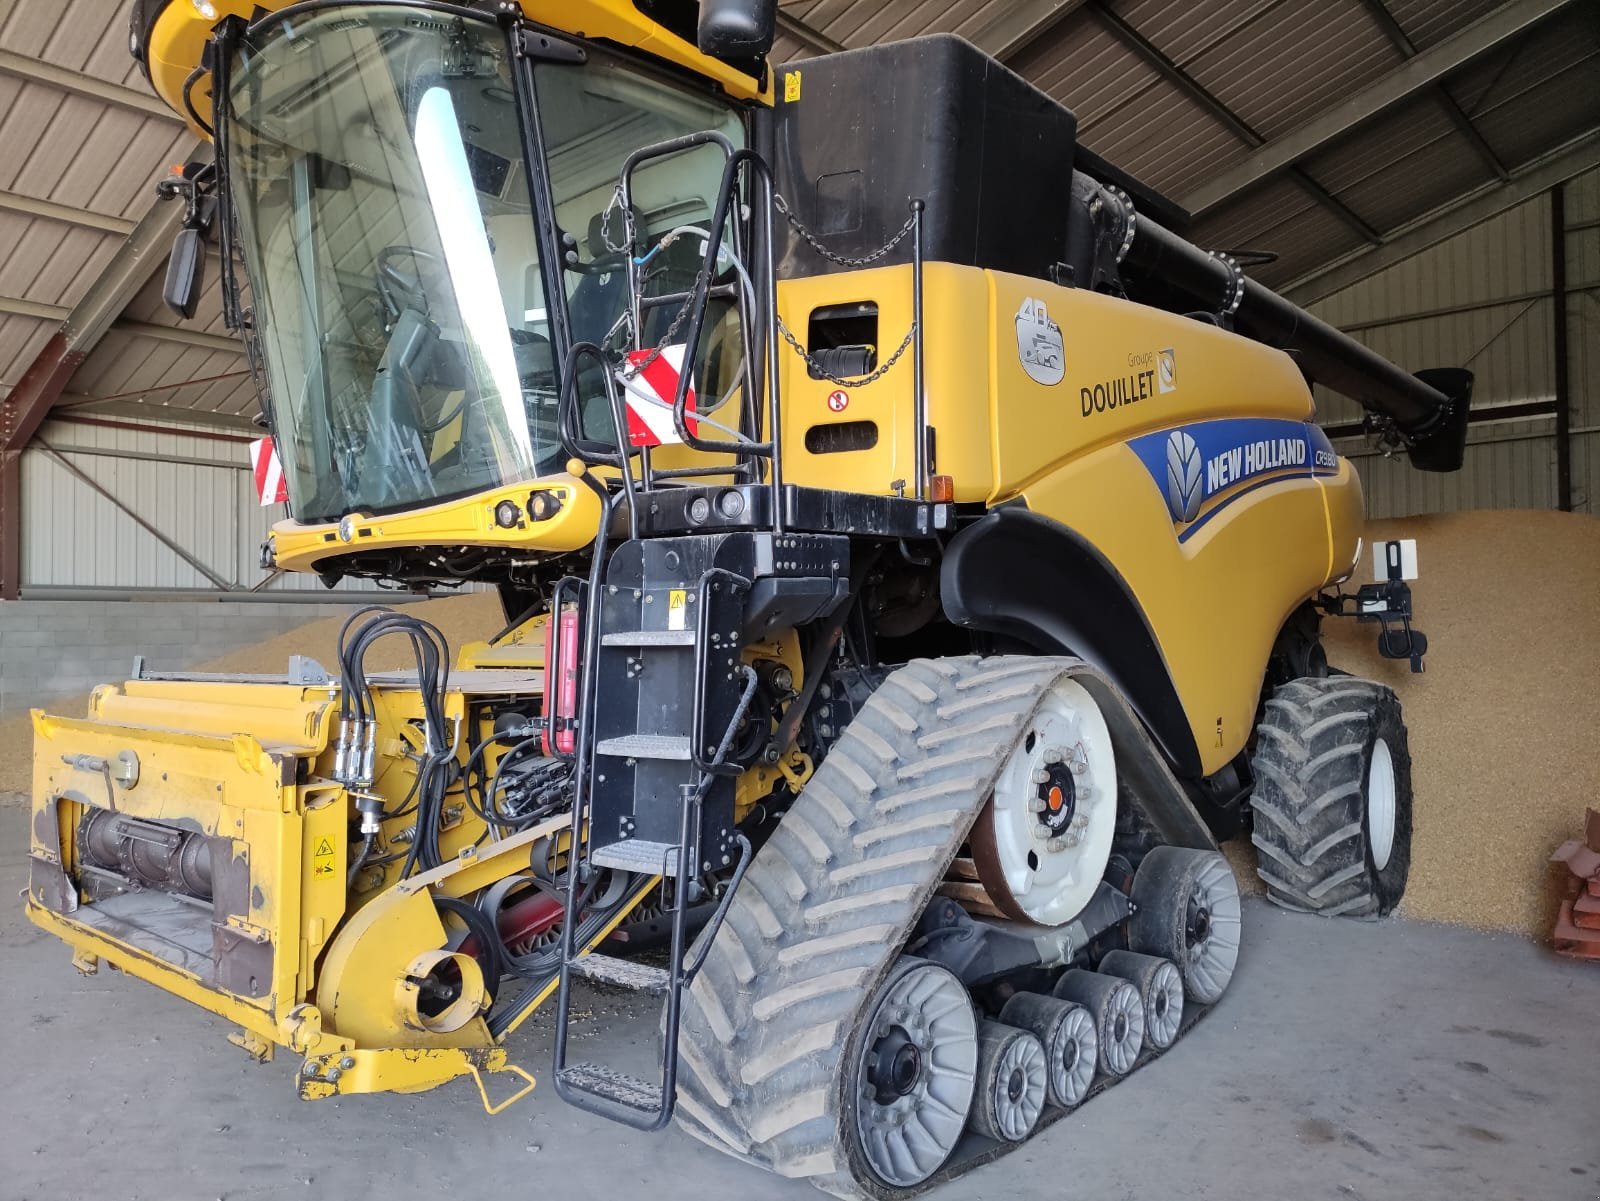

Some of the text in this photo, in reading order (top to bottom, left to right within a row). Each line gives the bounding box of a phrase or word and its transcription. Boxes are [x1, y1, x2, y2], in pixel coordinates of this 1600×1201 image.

[1127, 351, 1153, 367] Groupe
[1080, 370, 1154, 417] DOUILLET
[1207, 439, 1306, 494] NEW HOLLAND
